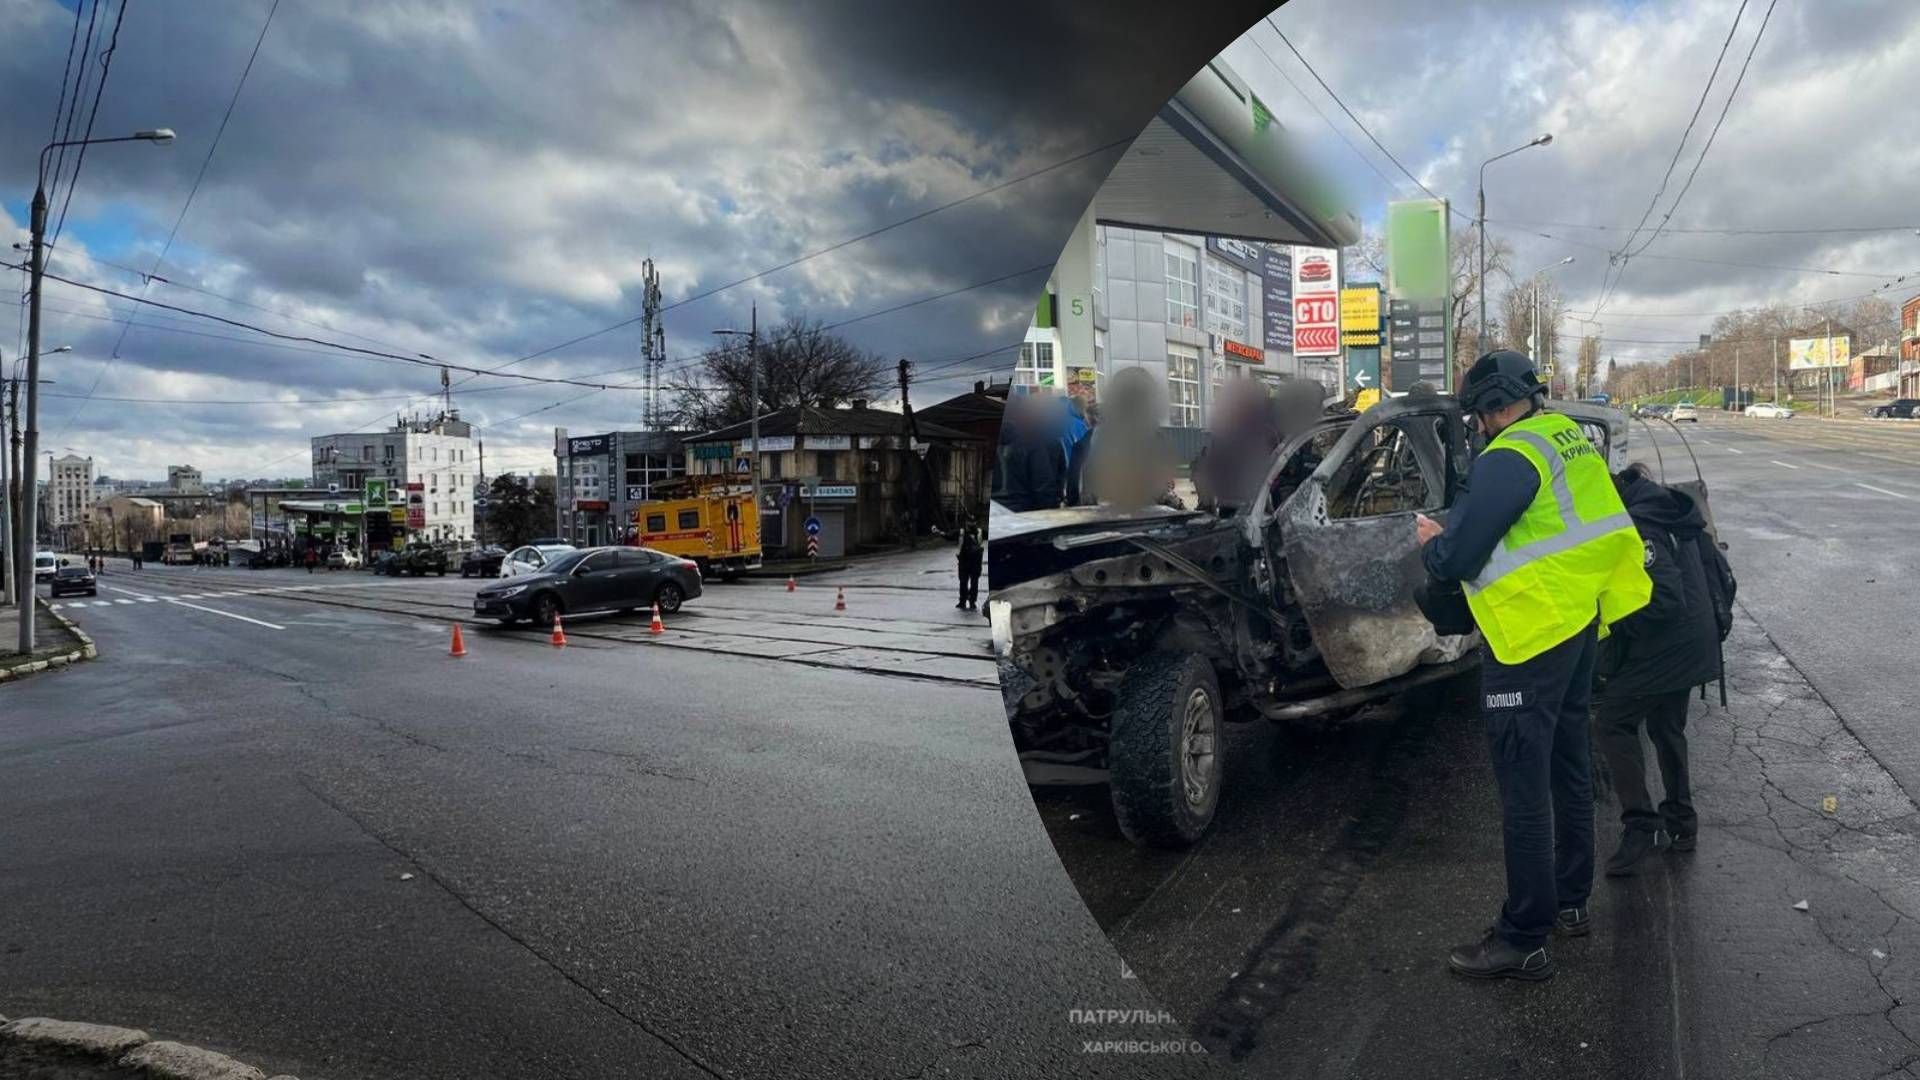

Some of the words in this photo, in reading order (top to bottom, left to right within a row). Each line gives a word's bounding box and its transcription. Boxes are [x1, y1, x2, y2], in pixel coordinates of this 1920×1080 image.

[1071, 299, 1084, 316] 5
[1297, 301, 1335, 322] СТО
[1552, 428, 1580, 446] ПО
[818, 486, 855, 495] SIEMENS
